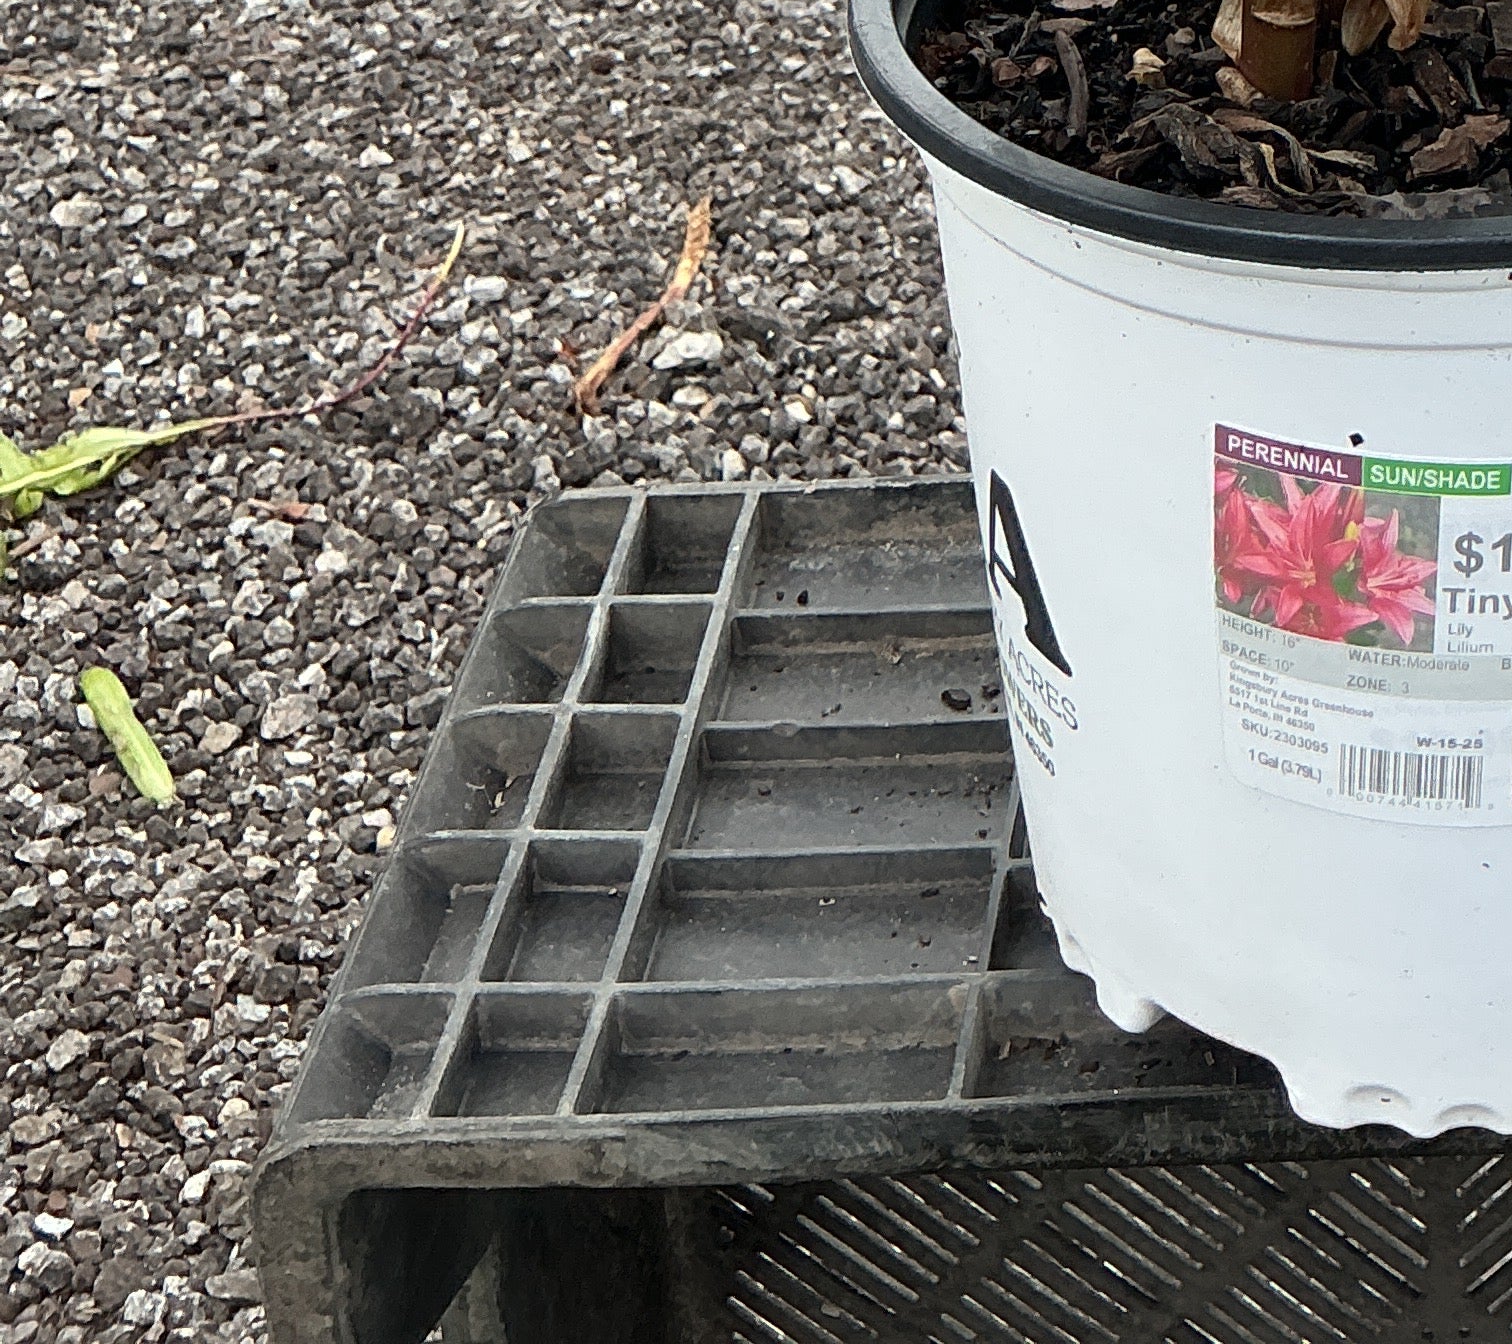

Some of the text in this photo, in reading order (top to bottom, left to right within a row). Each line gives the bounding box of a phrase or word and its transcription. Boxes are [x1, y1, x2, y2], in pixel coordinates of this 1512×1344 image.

[1227, 434, 1349, 480] PERENNIAL
[1370, 464, 1501, 490] SUN/SHADE
[1222, 613, 1277, 643] HEIGHT:
[1447, 623, 1474, 639] Lily
[1222, 639, 1271, 667] SPACE:
[1447, 641, 1494, 654] Lilium
[1008, 637, 1078, 731] ACRES
[1401, 680, 1410, 694] 3
[1416, 736, 1483, 749] W-15-25
[1248, 748, 1255, 761] 1
[1257, 752, 1279, 769] Gal
